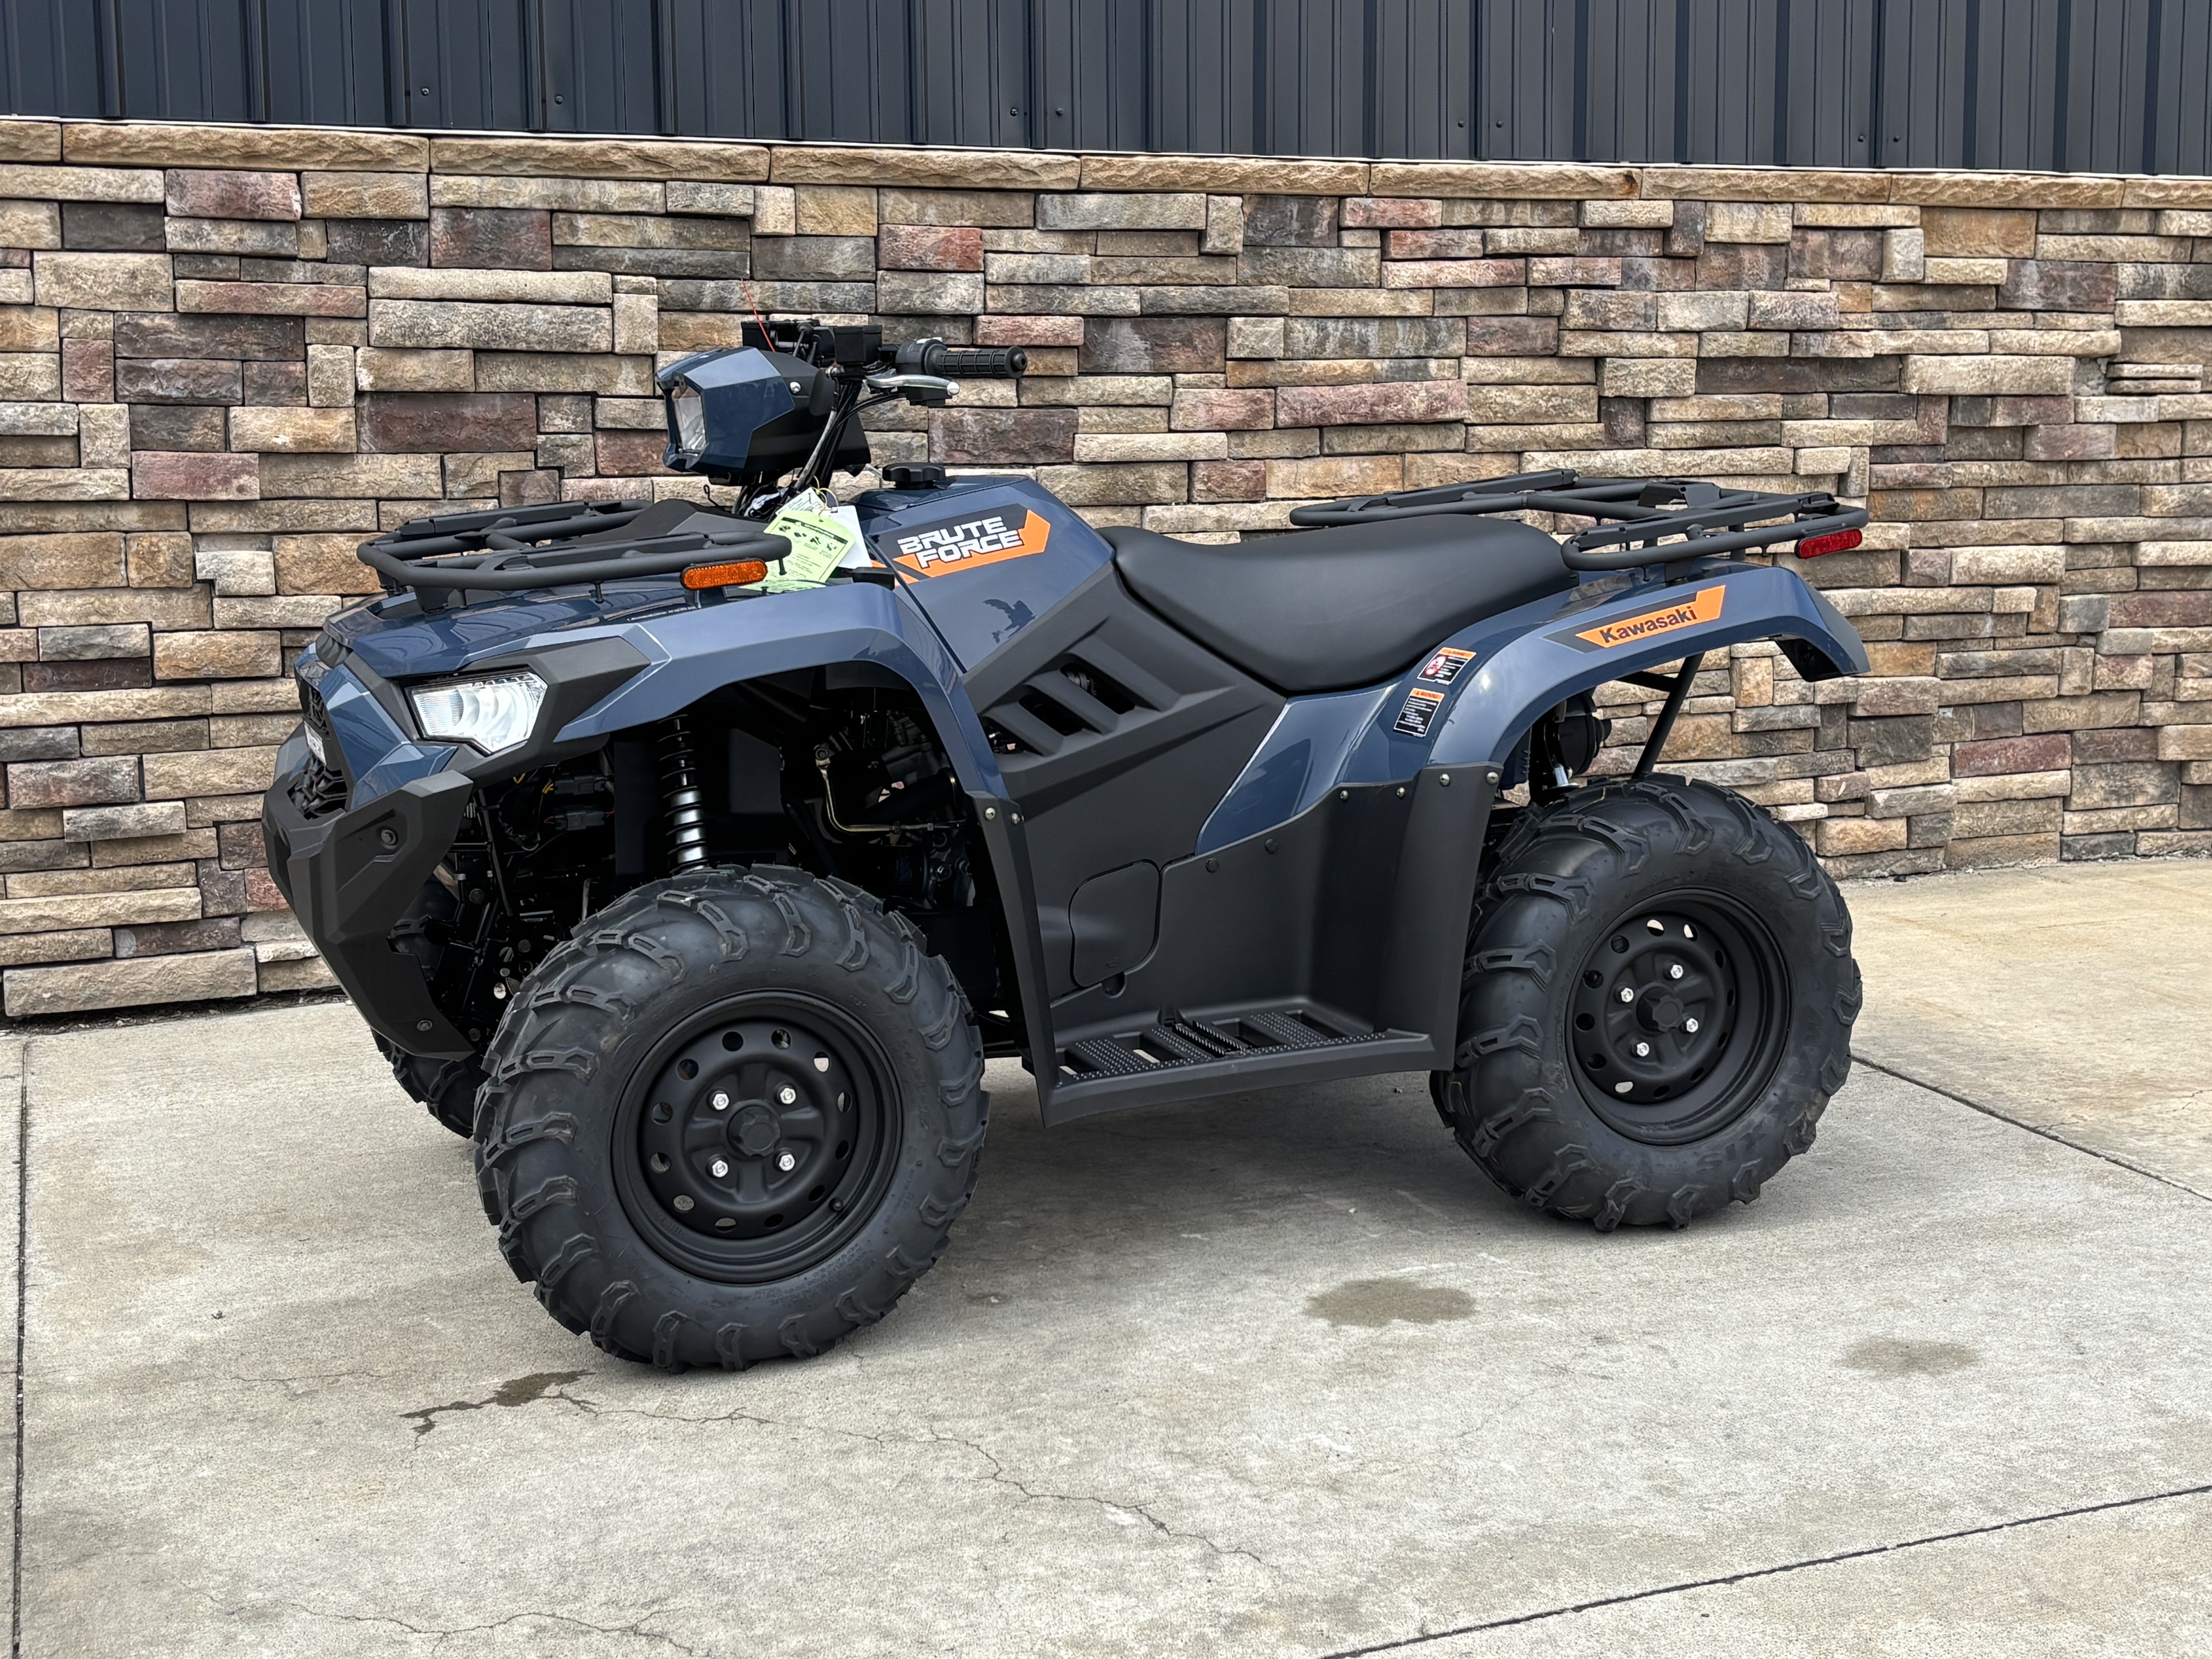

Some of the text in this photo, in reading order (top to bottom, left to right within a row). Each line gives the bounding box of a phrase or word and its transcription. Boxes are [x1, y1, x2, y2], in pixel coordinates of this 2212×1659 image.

[897, 516, 1007, 555] BRUTE
[915, 530, 1024, 568] FORCE
[1599, 606, 1698, 643] Kawasaki
